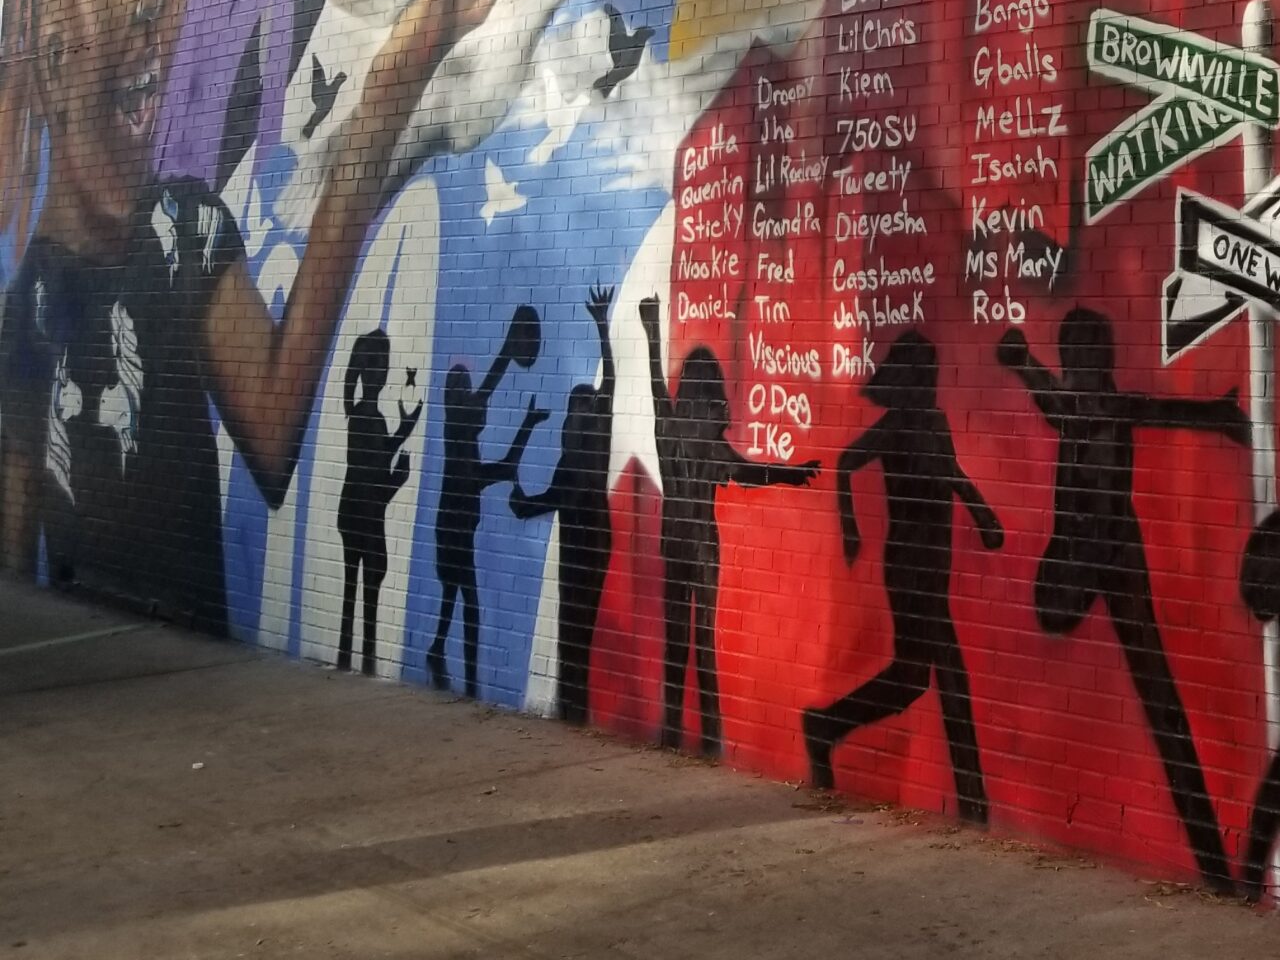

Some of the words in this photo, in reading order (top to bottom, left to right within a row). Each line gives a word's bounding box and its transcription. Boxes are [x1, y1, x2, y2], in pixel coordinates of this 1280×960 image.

[1101, 24, 1274, 116] BROWNVILLE
[833, 155, 911, 198] Tweety
[970, 145, 1058, 183] Isaiah
[681, 166, 744, 209] Quentin
[971, 195, 1044, 241] Kevin
[757, 248, 795, 283] Fred
[1213, 234, 1262, 277] ONE
[754, 295, 791, 323] Tim
[974, 285, 1026, 324] Rob
[749, 330, 821, 378] Viscious
[770, 384, 812, 429] Dog
